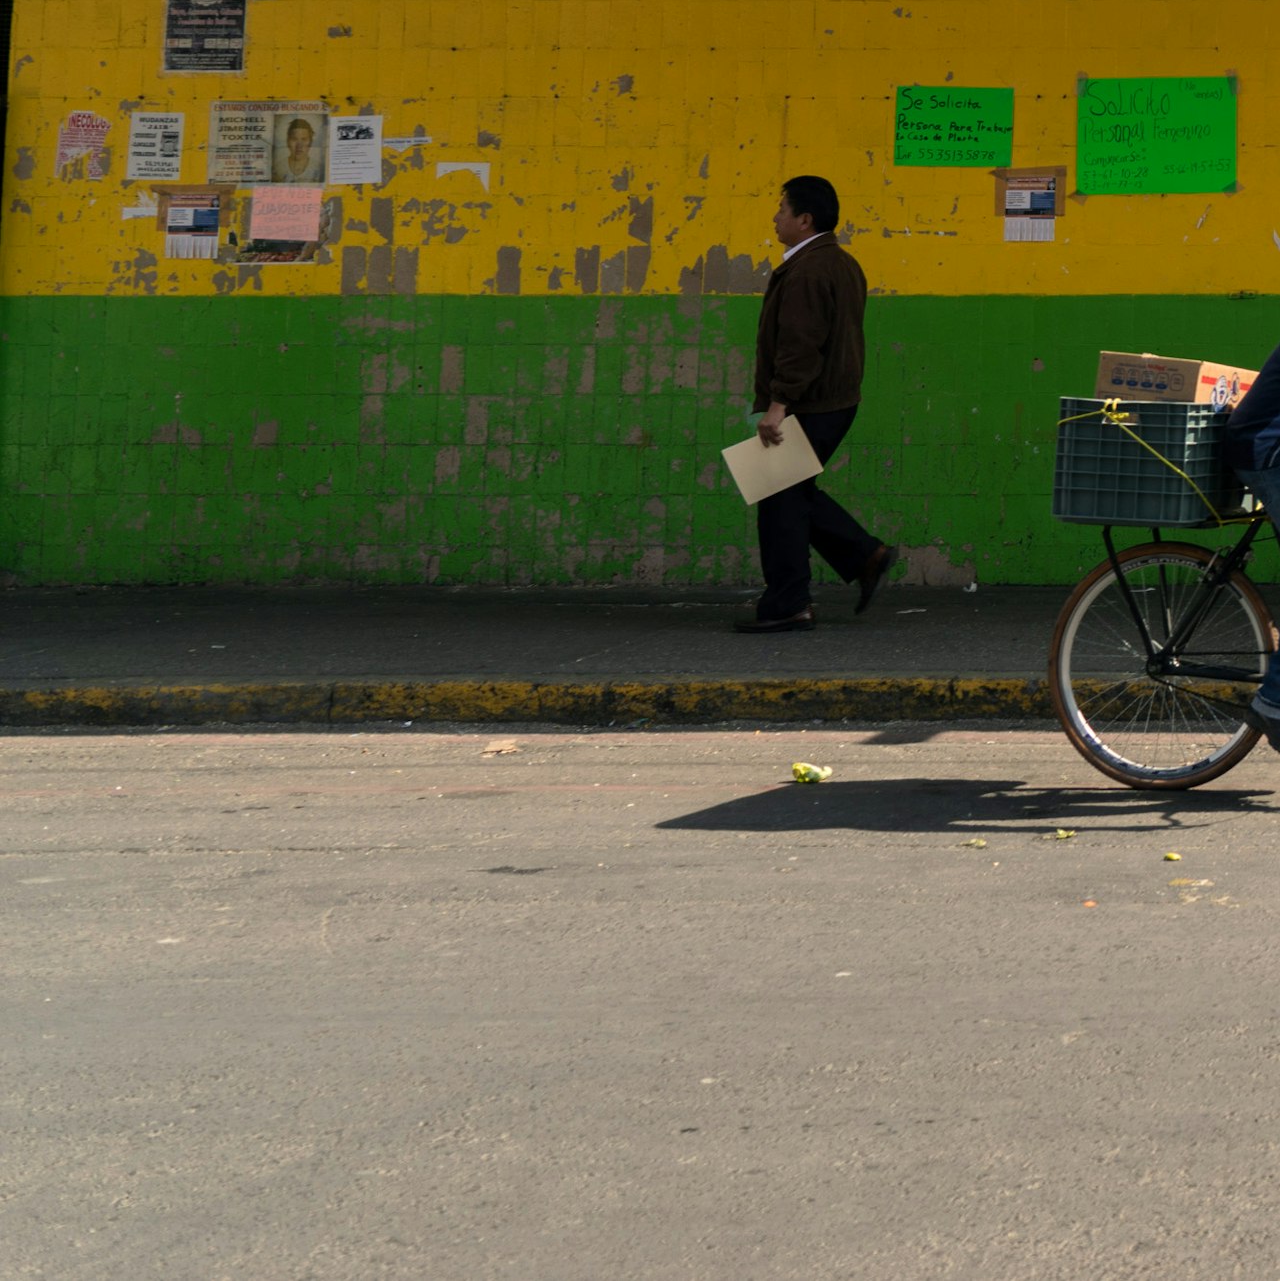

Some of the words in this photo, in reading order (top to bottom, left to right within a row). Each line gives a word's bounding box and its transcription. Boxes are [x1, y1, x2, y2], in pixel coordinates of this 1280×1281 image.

[902, 88, 924, 110] Se
[930, 94, 982, 110] Solicita
[218, 124, 267, 132] JIMENEZ
[1080, 117, 1144, 148] Personal
